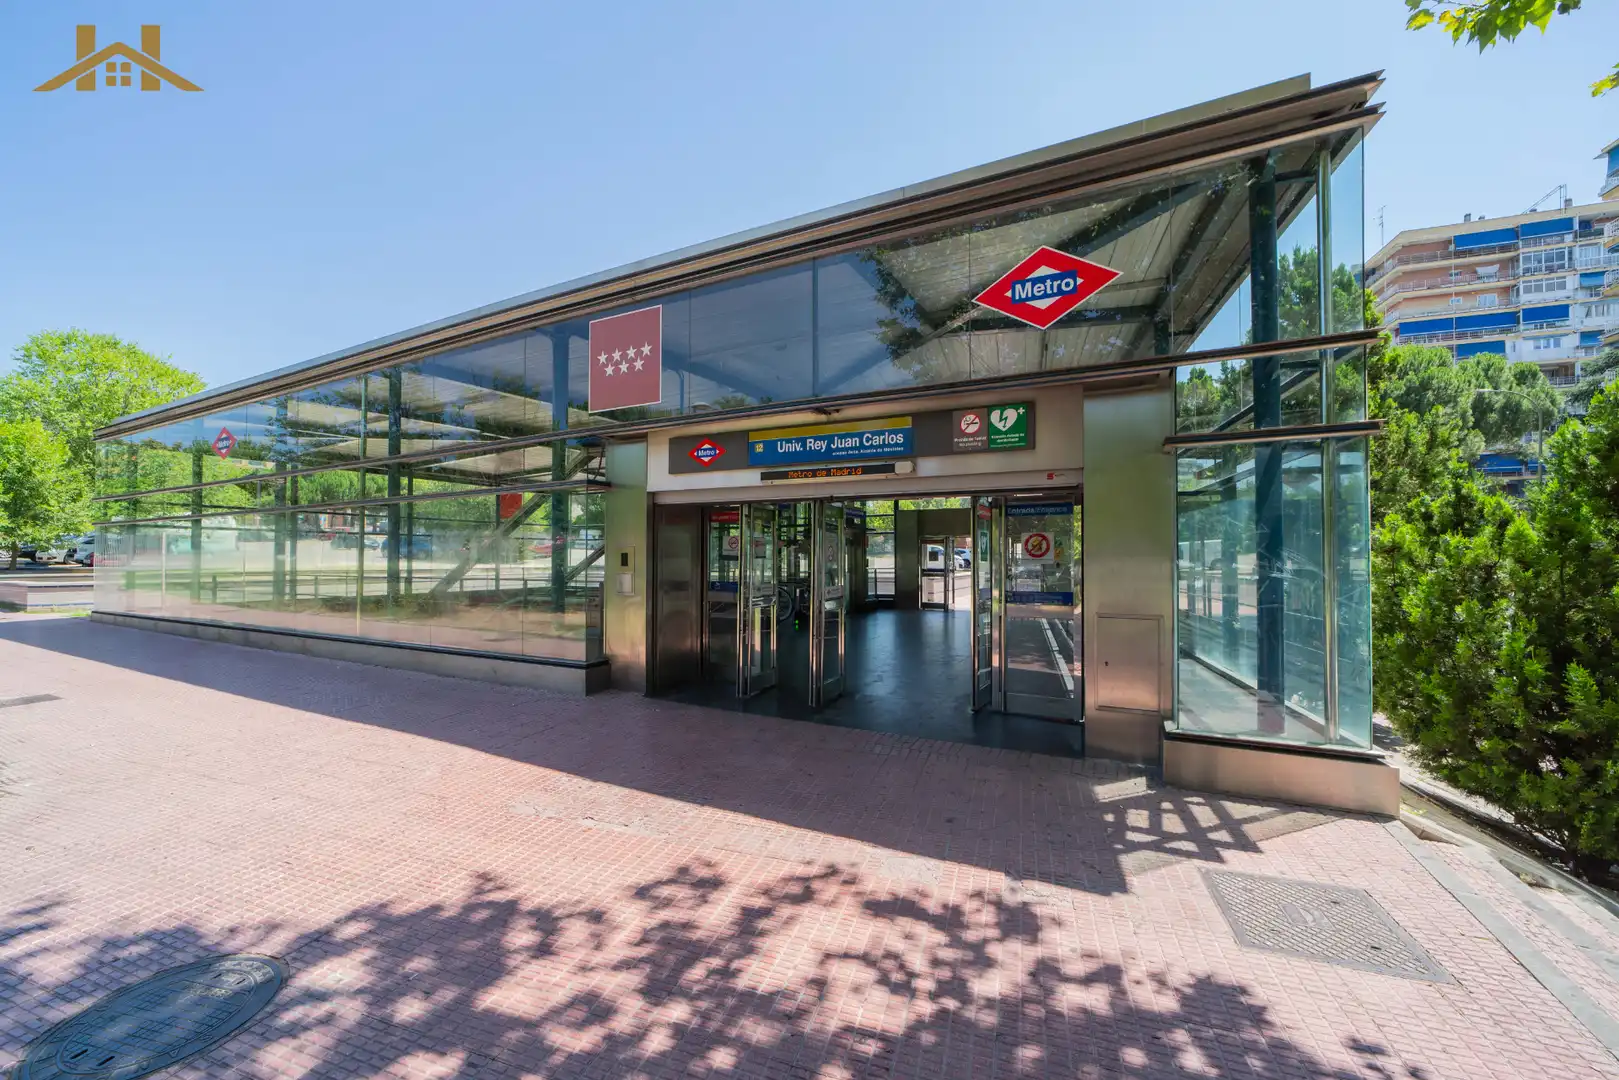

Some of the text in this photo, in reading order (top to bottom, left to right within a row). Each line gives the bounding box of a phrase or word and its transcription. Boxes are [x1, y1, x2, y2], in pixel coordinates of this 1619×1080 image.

[1014, 277, 1075, 300] Metro
[755, 443, 764, 452] 12
[777, 431, 904, 453] Univ. Rey Juan Carlos
[698, 449, 715, 457] Metro
[788, 467, 862, 479] Metro de Madrid
